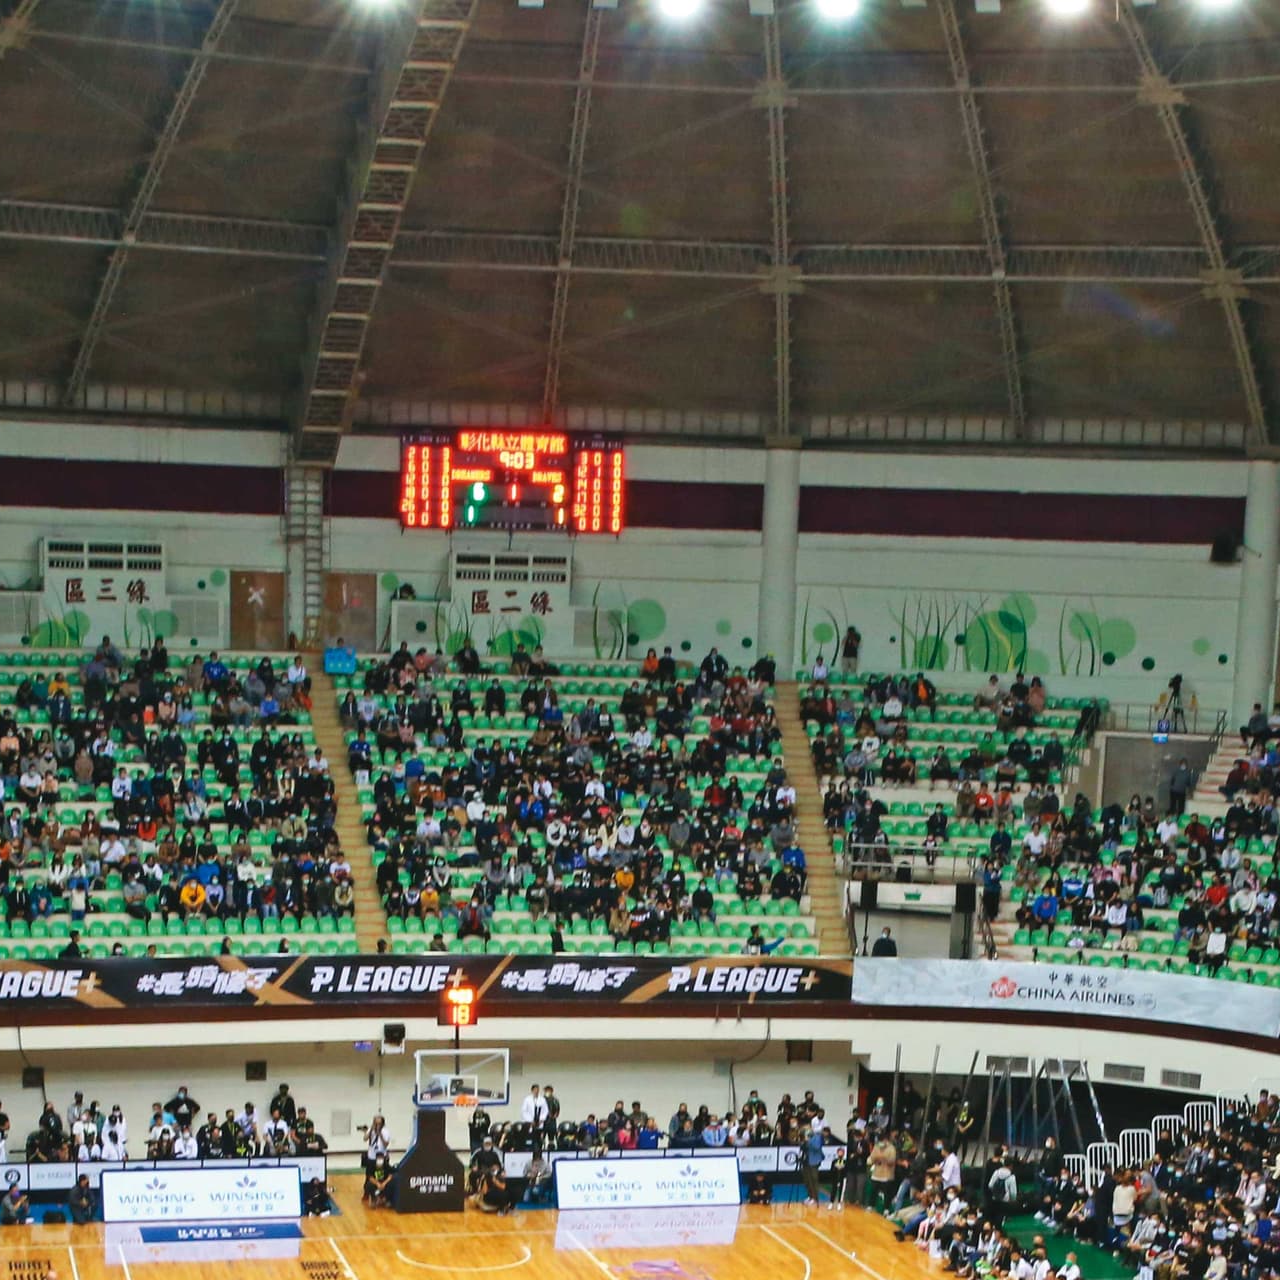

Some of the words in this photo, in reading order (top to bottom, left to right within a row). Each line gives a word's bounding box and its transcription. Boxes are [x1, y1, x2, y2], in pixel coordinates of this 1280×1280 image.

[422, 447, 429, 460] 0
[500, 451, 535, 469] 9:03
[594, 453, 601, 465] 0
[614, 453, 621, 466] 0
[422, 461, 429, 473] 0
[614, 466, 621, 479] 0
[422, 474, 429, 486] 0
[442, 475, 449, 487] 0
[594, 479, 600, 491] 0
[613, 479, 620, 492] 0
[422, 487, 429, 499] 0
[442, 487, 449, 500] 0
[553, 484, 565, 503] 2
[593, 492, 600, 505] 0
[613, 493, 620, 505] 0
[442, 500, 449, 513] 0
[593, 505, 600, 517] 0
[408, 512, 415, 525] 0
[422, 513, 428, 525] 0
[442, 513, 448, 526] 0
[579, 518, 585, 530] 0
[593, 518, 600, 530] 0
[612, 518, 619, 531] 0
[668, 966, 820, 993] P.LEAGUE+
[1048, 971, 1108, 989] 中華航空
[1017, 986, 1066, 1001] CHINA
[1070, 989, 1136, 1006] AIRLINES
[453, 1004, 469, 1024] 18
[410, 1173, 454, 1188] gamania
[572, 1181, 643, 1192] WINSING
[656, 1179, 725, 1190] WINSING
[119, 1192, 195, 1204] WINSING
[208, 1190, 285, 1201] WINSING
